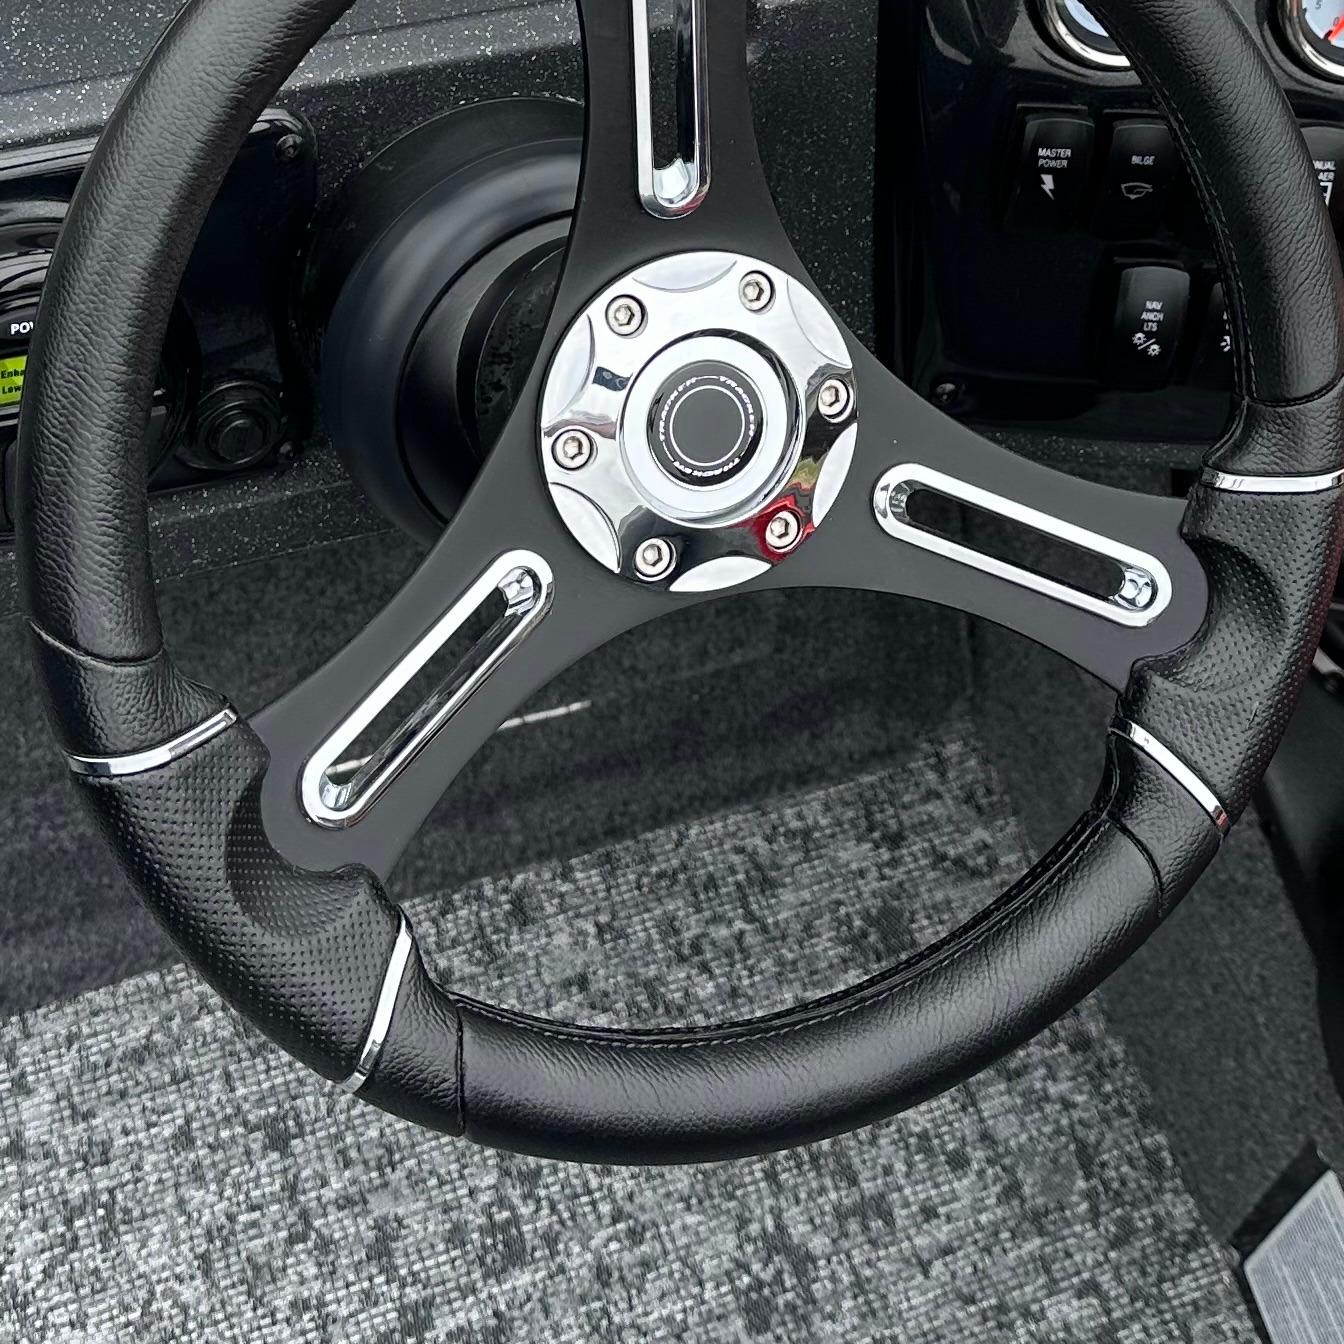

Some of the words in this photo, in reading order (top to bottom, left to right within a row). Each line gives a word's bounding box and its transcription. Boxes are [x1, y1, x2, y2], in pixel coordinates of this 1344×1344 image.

[1315, 0, 1323, 10] 5
[1037, 147, 1072, 158] MASTER
[1038, 158, 1068, 169] POWER
[1131, 155, 1155, 165] BILGE
[1145, 300, 1163, 310] NAV
[10, 321, 34, 335] PO
[1143, 321, 1158, 332] LTS
